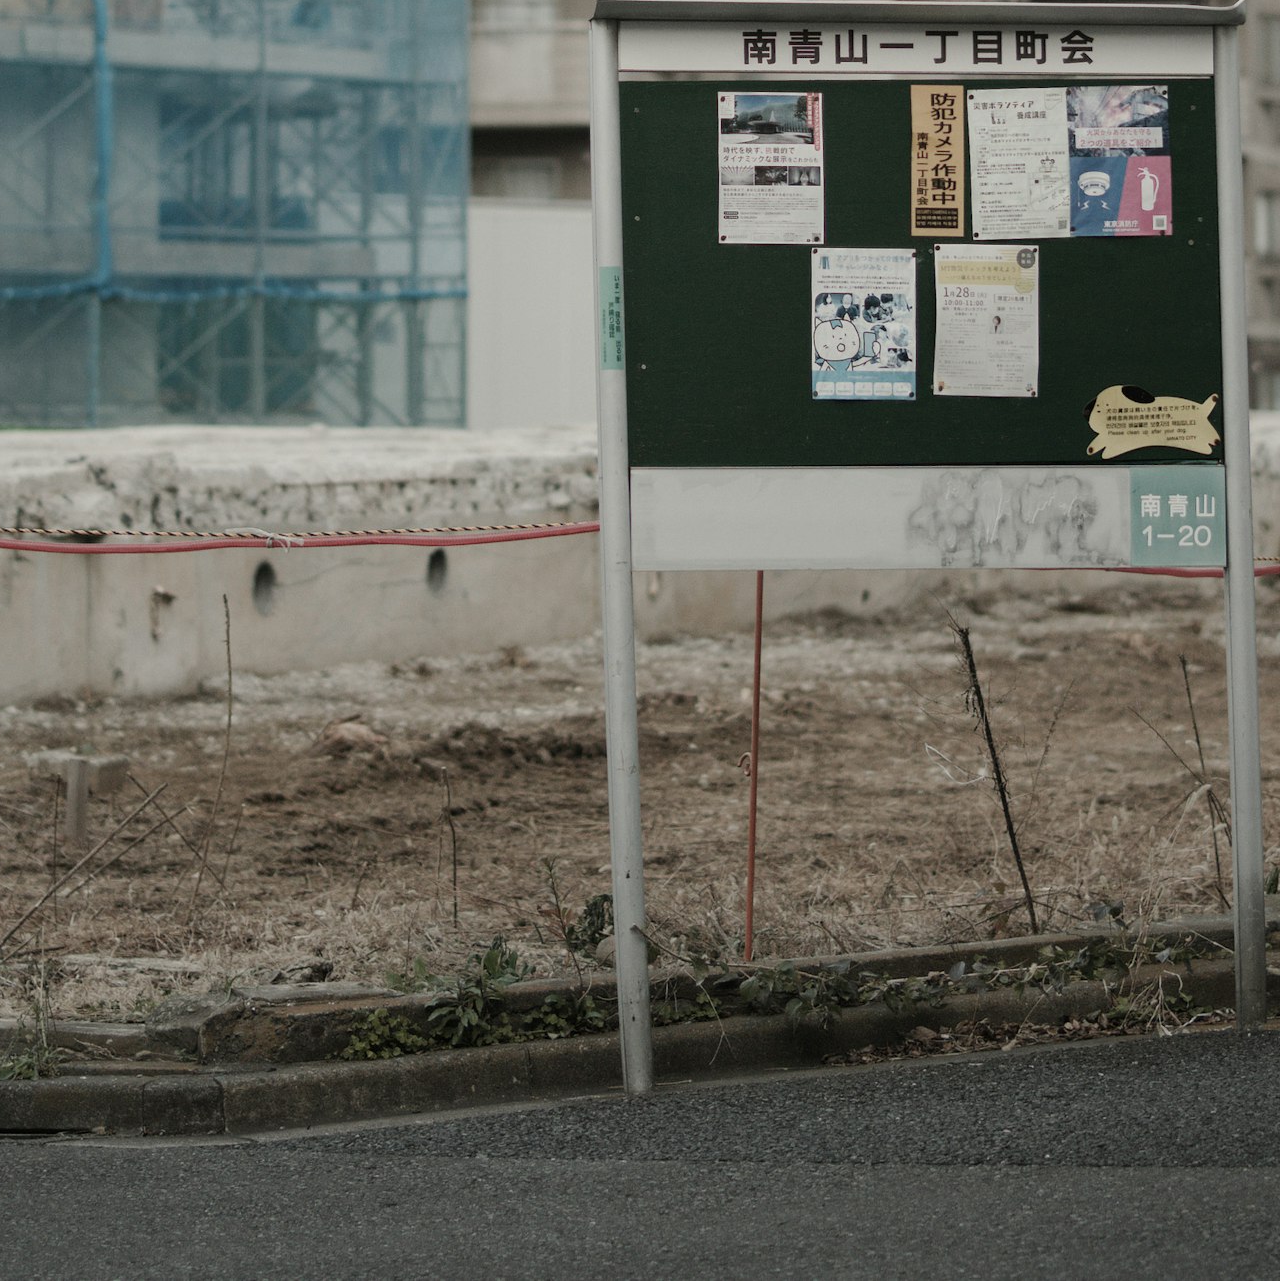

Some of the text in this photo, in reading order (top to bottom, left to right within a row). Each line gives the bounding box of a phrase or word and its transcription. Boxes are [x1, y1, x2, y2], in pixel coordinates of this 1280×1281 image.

[742, 28, 1096, 66] 南青山一丁目町会
[973, 101, 1034, 110] 災害ボランティア
[1086, 128, 1152, 136] 火災からあなたを守る
[930, 93, 957, 205] 防犯カメラ作動中
[917, 132, 929, 205] 南青山一丁目町会
[1140, 493, 1216, 518] 南青山
[1141, 525, 1212, 547] 1-20
